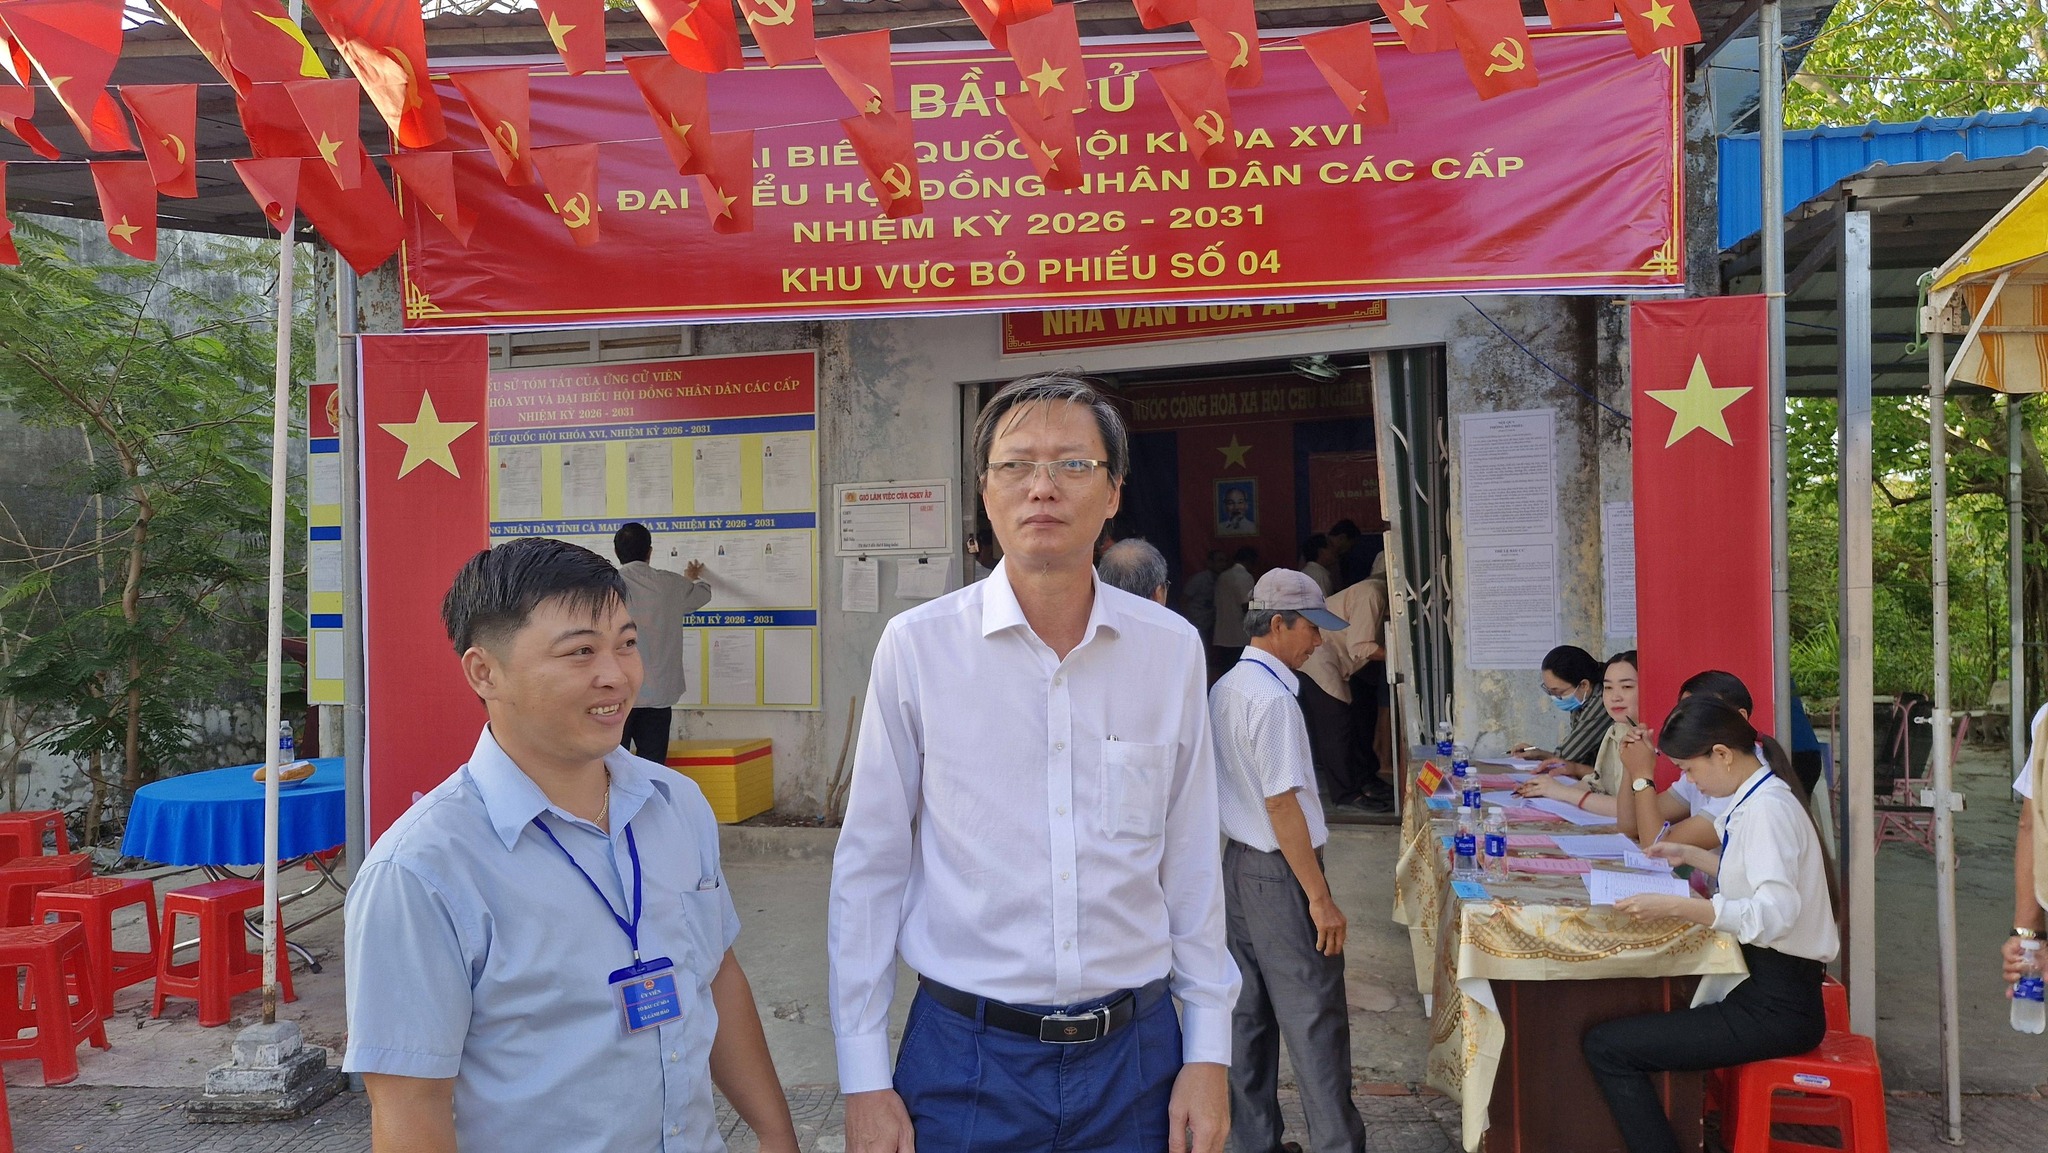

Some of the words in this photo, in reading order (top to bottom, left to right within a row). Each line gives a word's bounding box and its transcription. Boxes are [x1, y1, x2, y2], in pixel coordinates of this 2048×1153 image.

[913, 130, 1029, 164] QUỐC
[1076, 129, 1128, 160] ỘI
[1289, 123, 1362, 147] XVI
[616, 187, 689, 215] ĐẠI
[752, 173, 808, 207] ỂU
[825, 178, 880, 207] HỘ
[919, 168, 1046, 201] ĐỒNG
[1207, 160, 1301, 189] DÂN
[1318, 155, 1415, 184] CÁC
[1431, 147, 1524, 180] CẤP
[793, 213, 934, 245] NHIỆM
[953, 209, 1012, 238] KỲ
[1027, 210, 1126, 235] 2026
[1169, 204, 1263, 229] 2031
[781, 265, 862, 293] KHU
[875, 259, 955, 294] VỰC
[969, 250, 1026, 287] BỎ
[1038, 244, 1157, 284] PHIẾU
[1170, 240, 1226, 279] SỐ
[1237, 249, 1281, 276] 04
[489, 394, 513, 408] HÓA
[516, 396, 535, 407] XVI
[538, 393, 553, 405] VÀ
[557, 394, 578, 406] ĐẠI
[581, 388, 609, 403] BIỂU
[613, 388, 635, 403] HỘI
[638, 384, 673, 399] ĐỒNG
[676, 383, 711, 397] NHÂN
[715, 382, 742, 395] DÂN
[744, 379, 770, 394] CÁC
[773, 375, 800, 392] CẤP
[504, 376, 519, 391] SỬ
[522, 376, 547, 390] TÓM
[550, 373, 573, 388] TẮT
[575, 372, 600, 387] CỦA
[603, 370, 629, 386] ỨNG
[632, 369, 649, 384] CỬ
[652, 368, 682, 382] VIÊN
[518, 409, 556, 423] NHIỆM
[560, 407, 576, 420] KỲ
[579, 408, 602, 419] 2026
[611, 407, 635, 418] 2031
[509, 429, 537, 443] QUỐC
[538, 429, 557, 442] HỘI
[559, 428, 587, 440] KHÓA
[588, 429, 608, 439] XVI,
[610, 426, 644, 438] NHIỆM
[646, 424, 660, 436] KỲ
[662, 425, 683, 435] 2026
[691, 424, 711, 434] 2031
[489, 526, 501, 535] NG
[503, 523, 531, 534] NHÂN
[533, 523, 553, 534] DÂN
[556, 521, 580, 533] TỈNH
[582, 522, 596, 532] CÀ
[598, 523, 620, 532] MAU
[656, 521, 669, 531] XI,
[672, 519, 706, 531] NHIỆM
[708, 517, 723, 528] KỲ
[725, 519, 747, 528] 2026
[754, 518, 776, 528] 2031
[707, 613, 722, 624] KỲ
[724, 615, 746, 624] 2026
[753, 615, 774, 624] 2031
